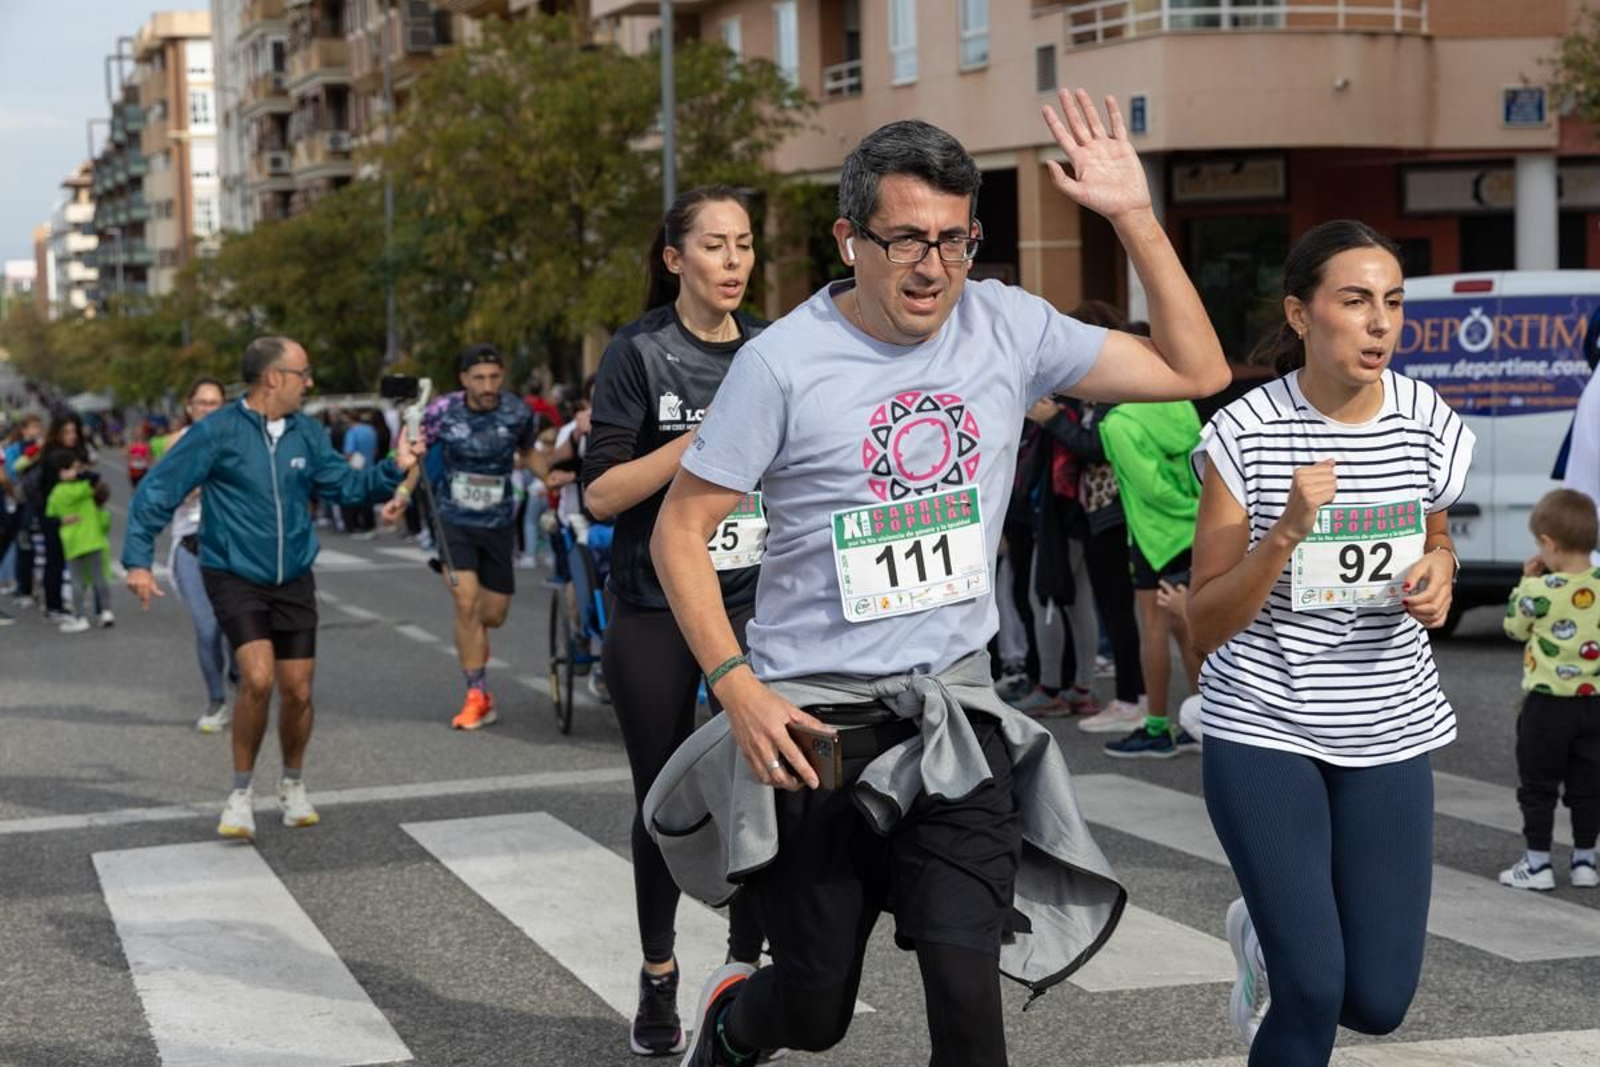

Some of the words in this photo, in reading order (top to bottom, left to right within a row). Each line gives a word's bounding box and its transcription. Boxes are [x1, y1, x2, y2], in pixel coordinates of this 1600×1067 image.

[1395, 309, 1588, 353] DEPORTIM
[872, 491, 971, 521] CARRERA
[874, 505, 972, 534] POPULAR
[1333, 503, 1415, 520] CARRERA
[708, 522, 738, 551] 5
[1333, 514, 1415, 533] POPULAR
[875, 534, 953, 587] 111
[1339, 542, 1393, 583] 92
